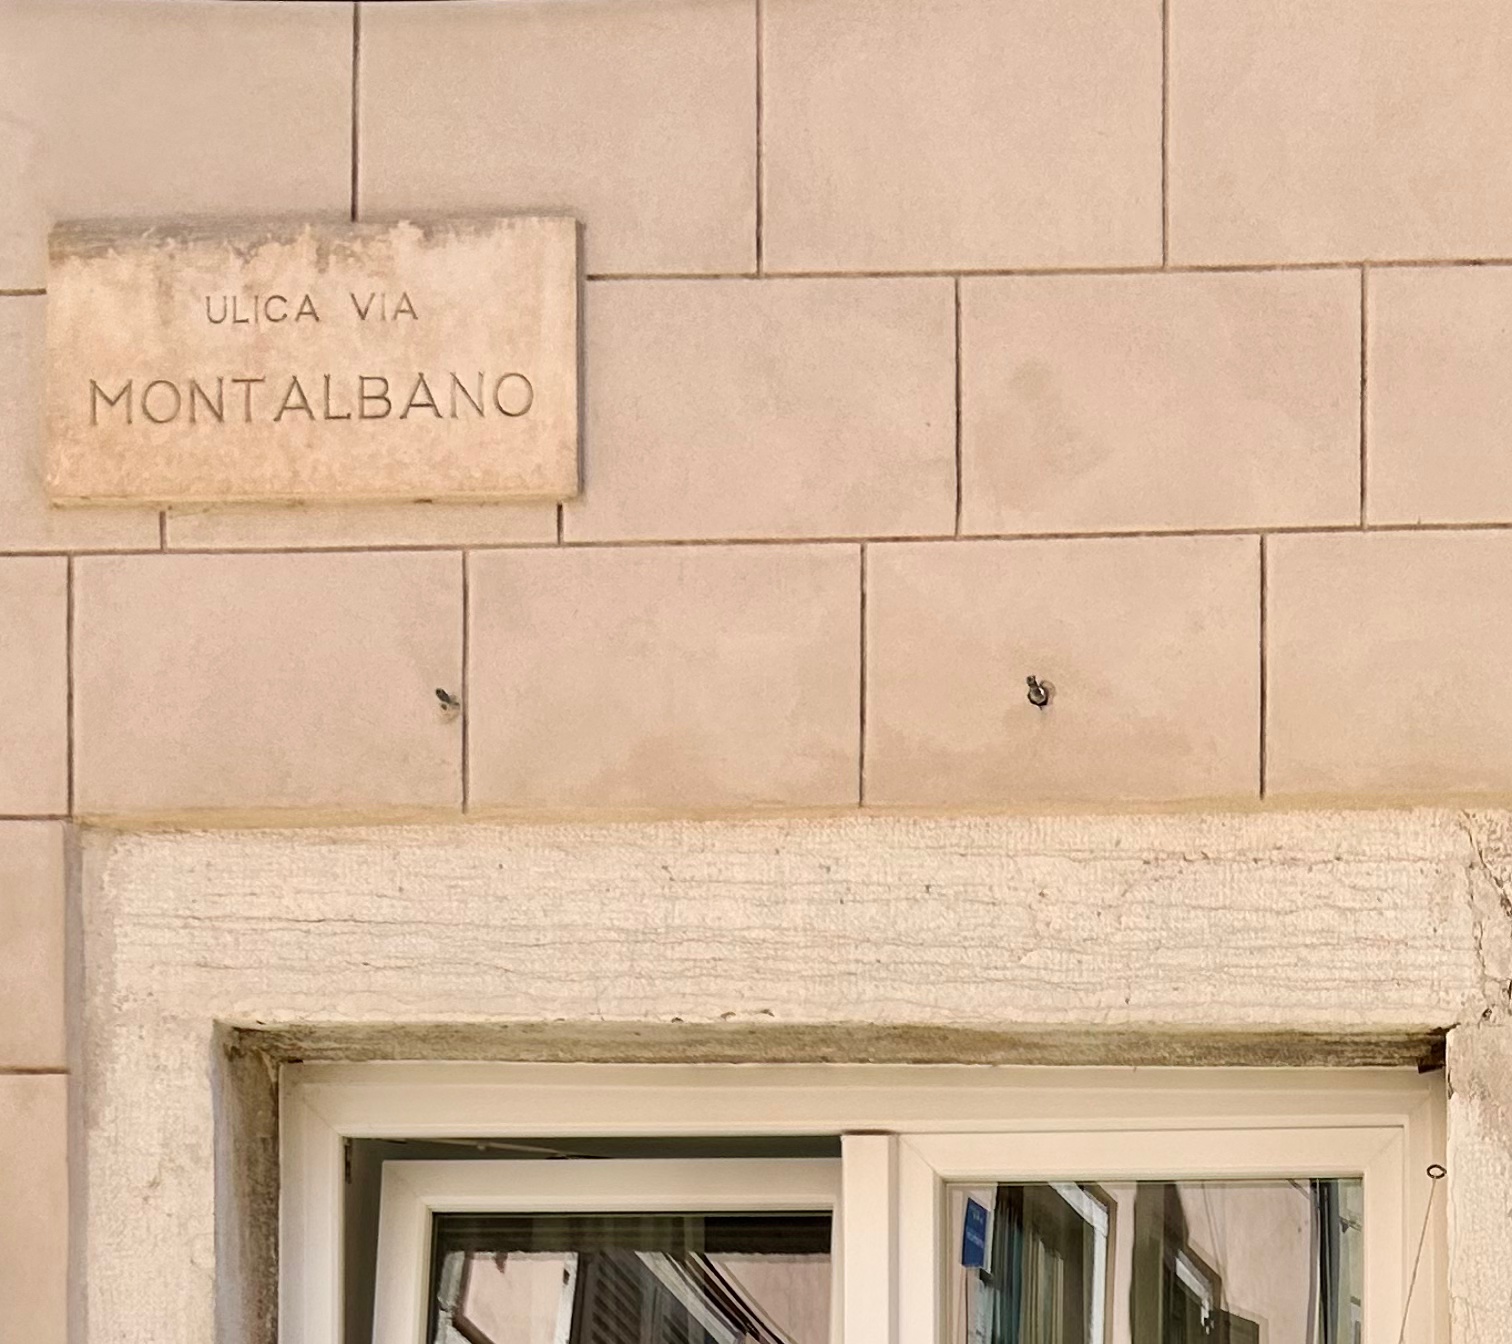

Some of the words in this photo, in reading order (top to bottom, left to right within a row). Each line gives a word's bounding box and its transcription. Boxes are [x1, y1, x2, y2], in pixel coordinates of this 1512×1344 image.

[206, 293, 320, 324] ULICA
[351, 291, 418, 321] VIA
[88, 371, 535, 425] MONTALBANO
